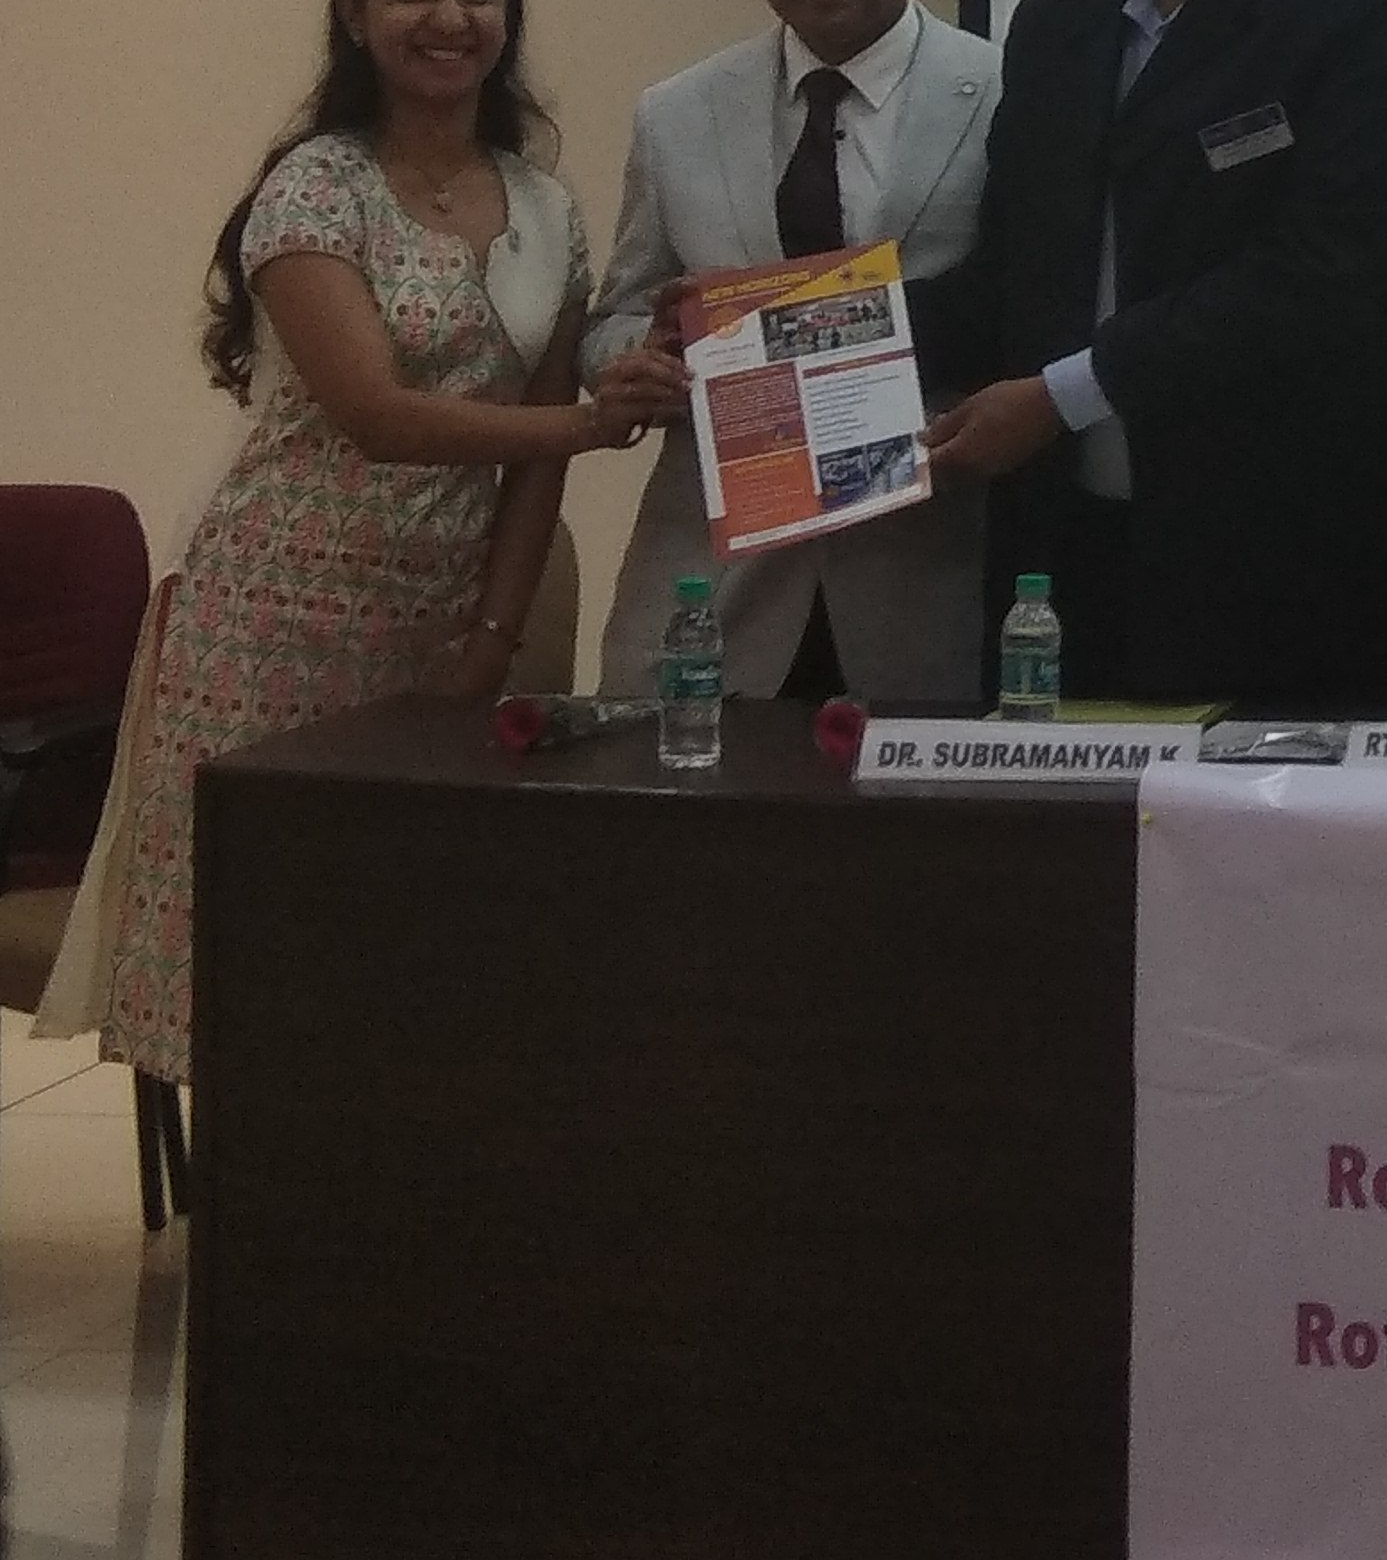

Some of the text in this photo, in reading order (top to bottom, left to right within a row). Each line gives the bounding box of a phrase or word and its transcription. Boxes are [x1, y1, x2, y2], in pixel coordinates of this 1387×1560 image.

[876, 741, 1181, 770] DR. SUBRAMANYAM K
